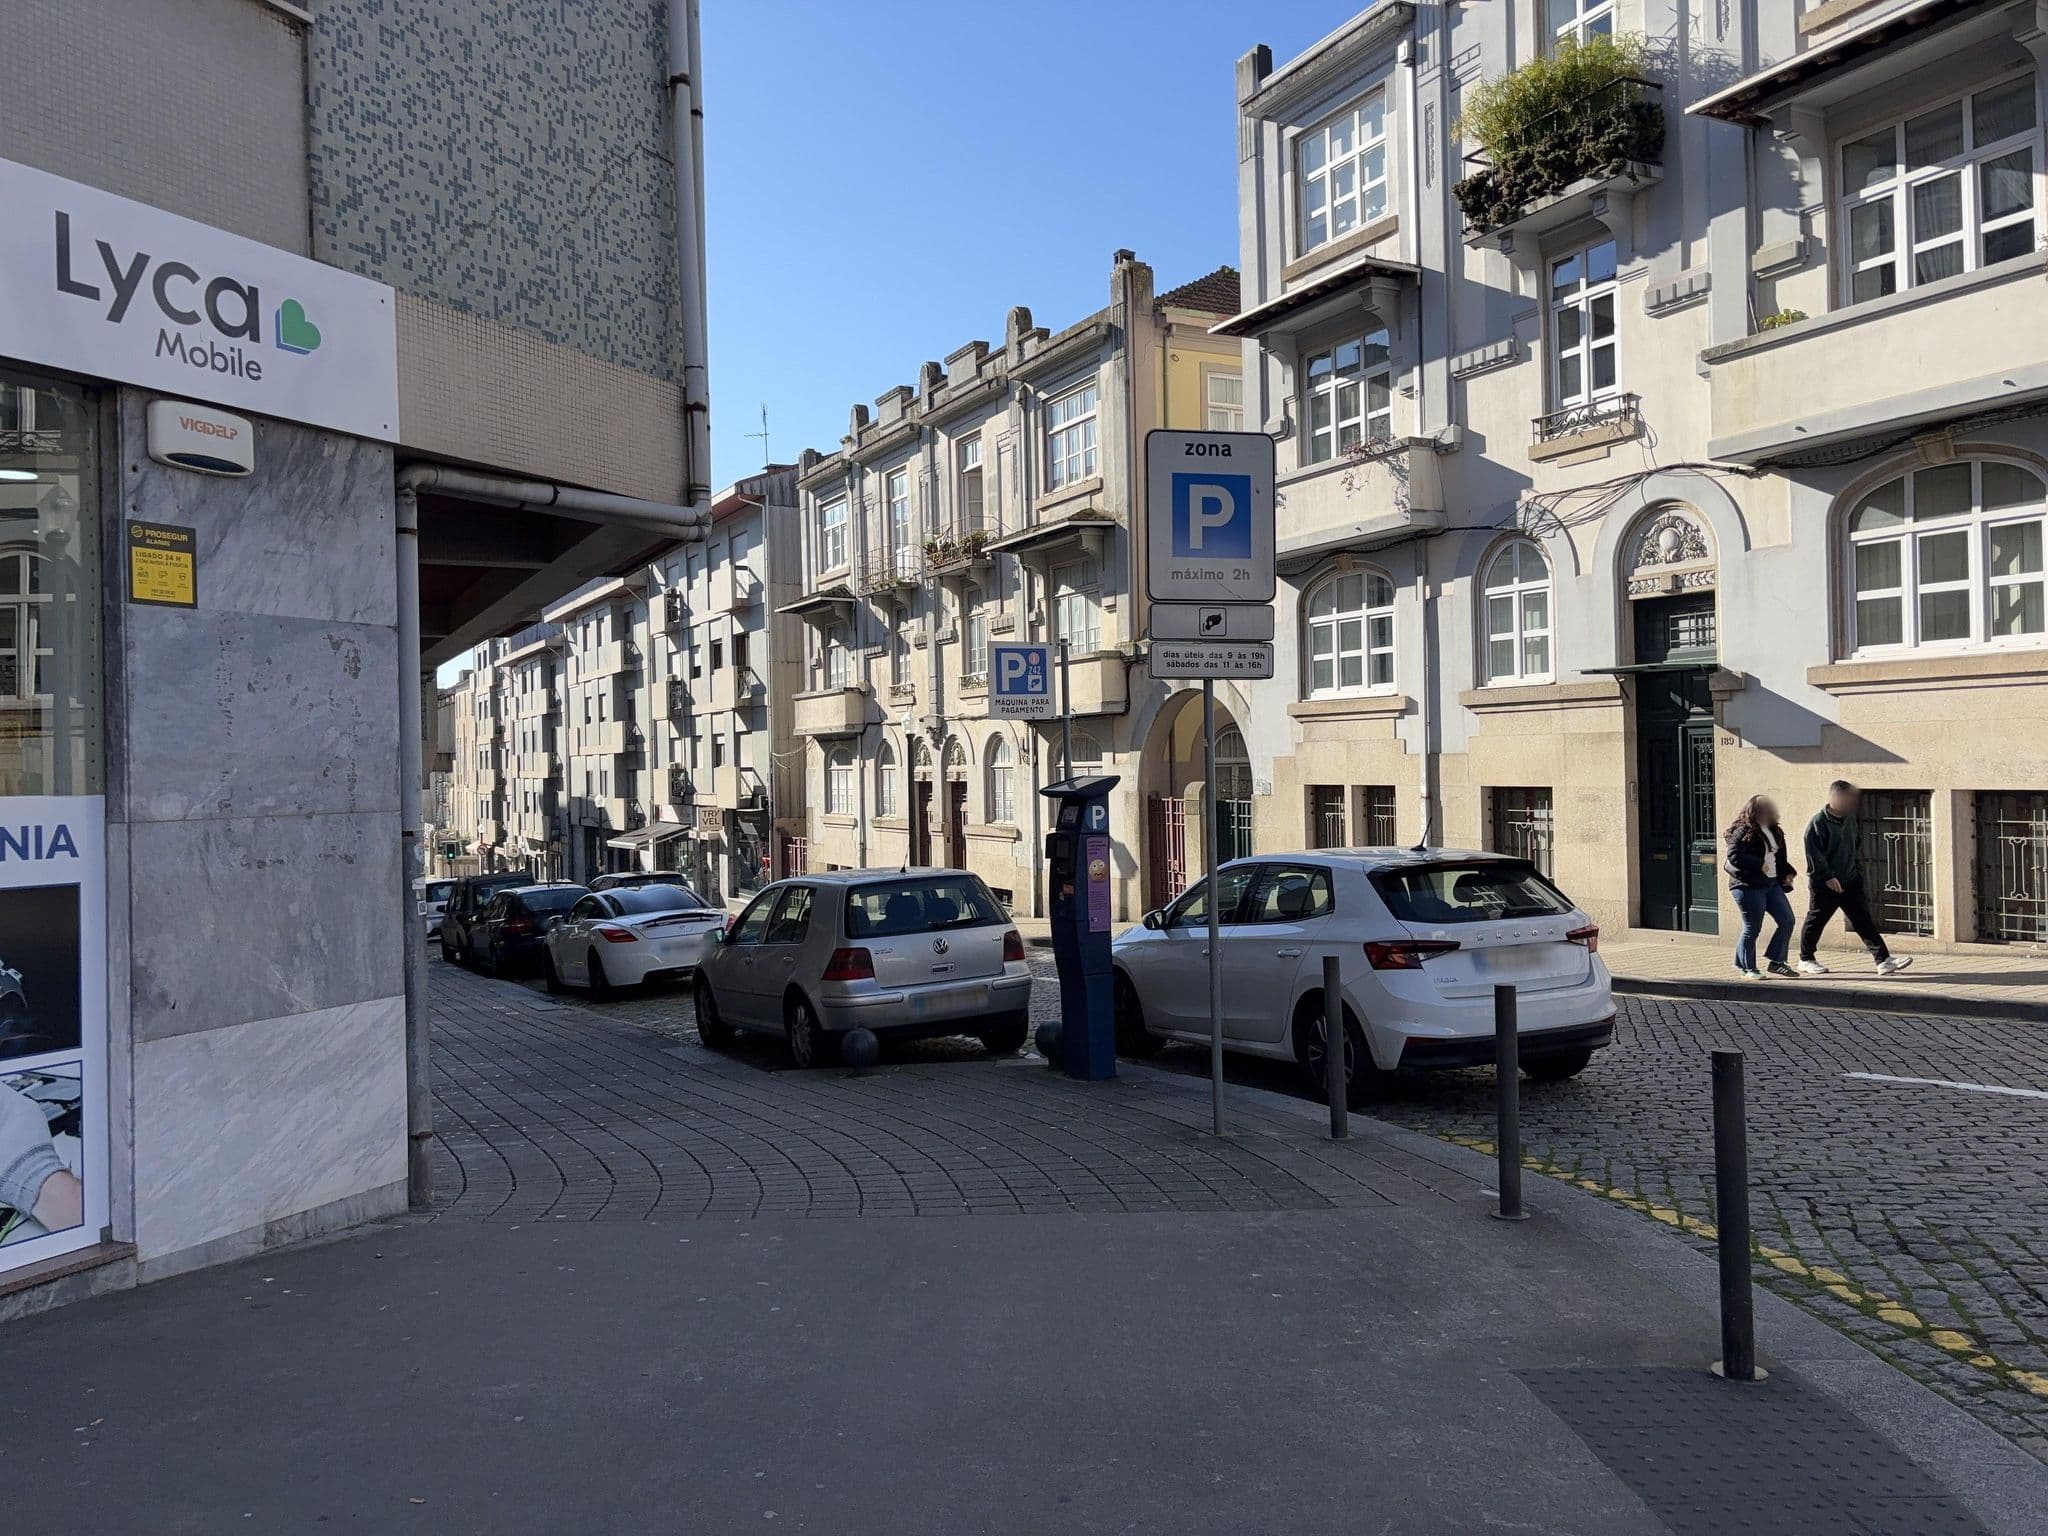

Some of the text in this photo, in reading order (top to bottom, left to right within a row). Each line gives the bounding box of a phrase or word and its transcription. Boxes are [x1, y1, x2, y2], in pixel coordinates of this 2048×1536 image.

[55, 210, 261, 343] Lyca
[155, 328, 262, 381] Mobile
[1185, 442, 1232, 457] zona
[1189, 484, 1235, 549] P
[145, 529, 188, 541] PROSEGUR
[1171, 567, 1250, 580] máximo 2h
[1209, 651, 1223, 659] das
[1227, 651, 1233, 659] 9
[1251, 652, 1265, 660] 19h
[1001, 652, 1026, 691] P
[1166, 660, 1199, 668] sábados
[1204, 660, 1218, 668] das
[1248, 661, 1262, 669] 16h
[702, 809, 720, 818] TRY
[1092, 805, 1105, 829] P
[702, 817, 720, 825] VEL
